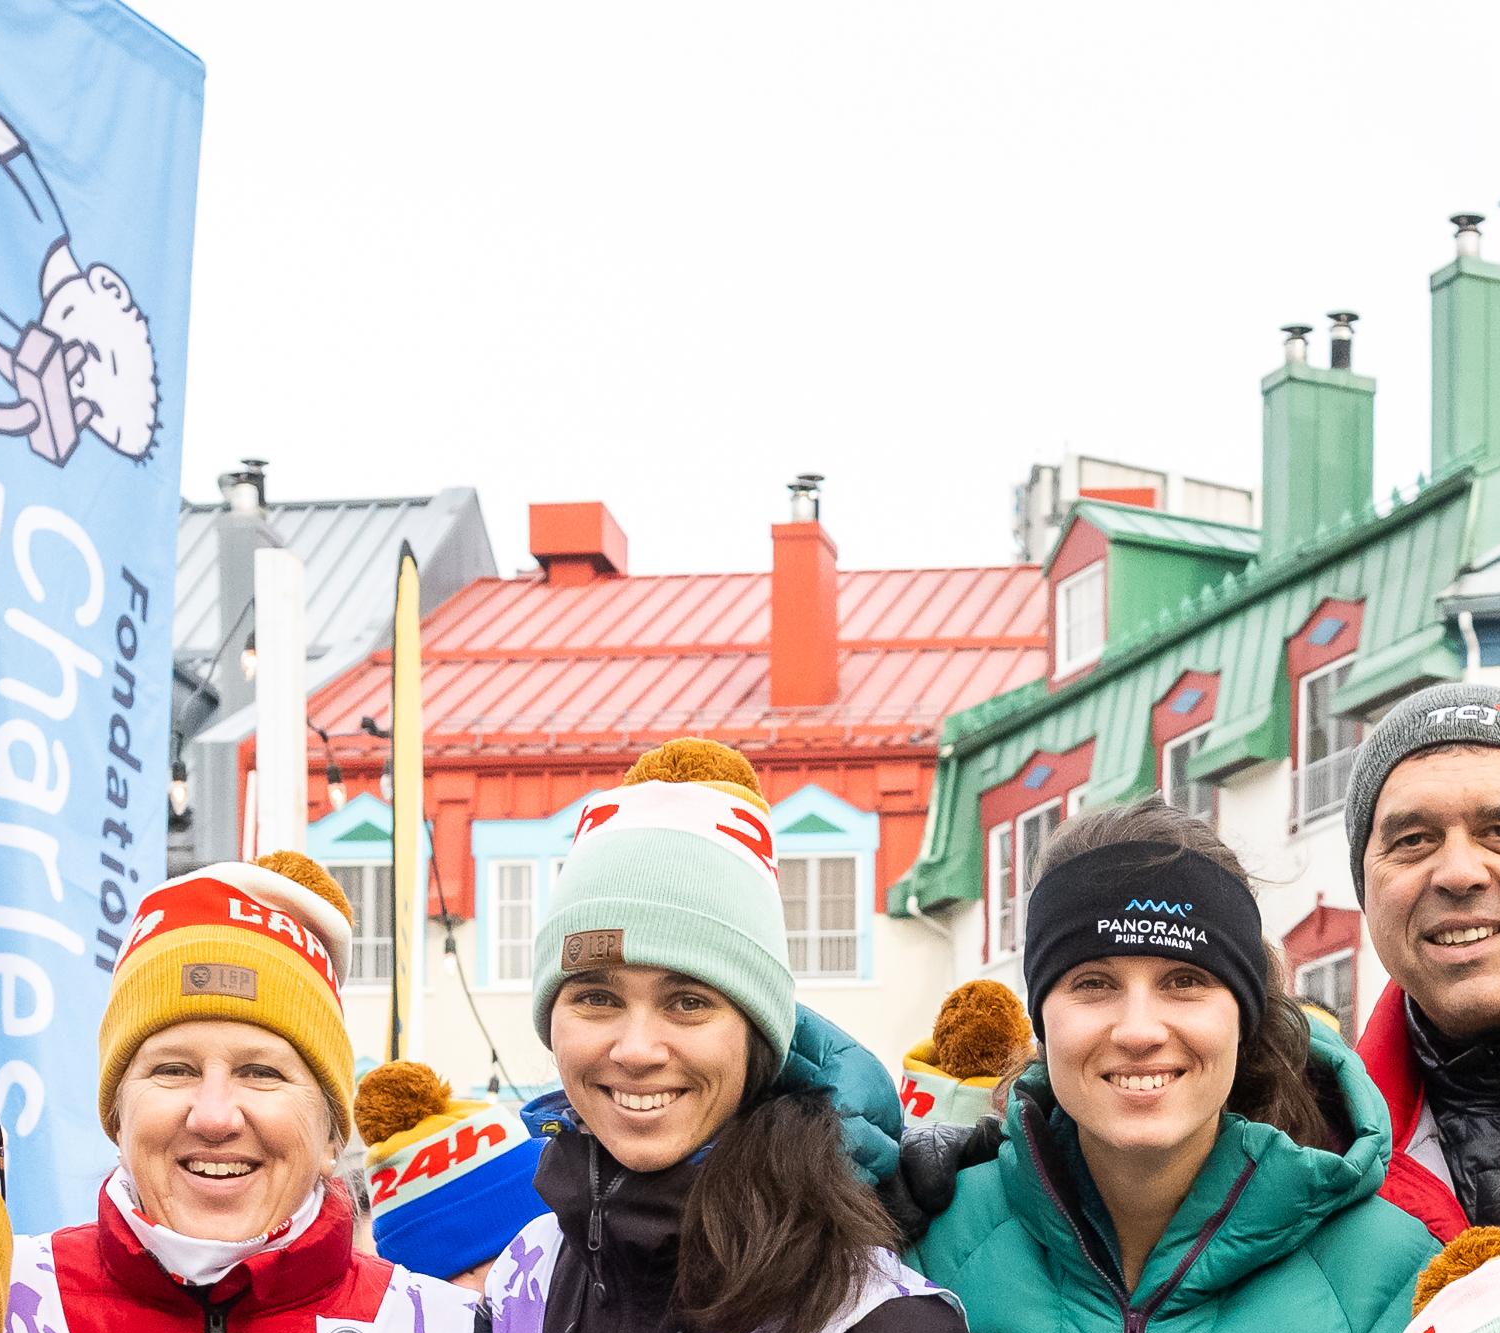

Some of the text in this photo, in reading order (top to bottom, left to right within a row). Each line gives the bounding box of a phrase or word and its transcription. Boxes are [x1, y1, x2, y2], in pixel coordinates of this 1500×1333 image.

[94, 566, 148, 974] Fondation
[1097, 918, 1208, 945] PANORAMA
[1115, 933, 1193, 951] PURE CANADA
[371, 1122, 506, 1208] 24h
